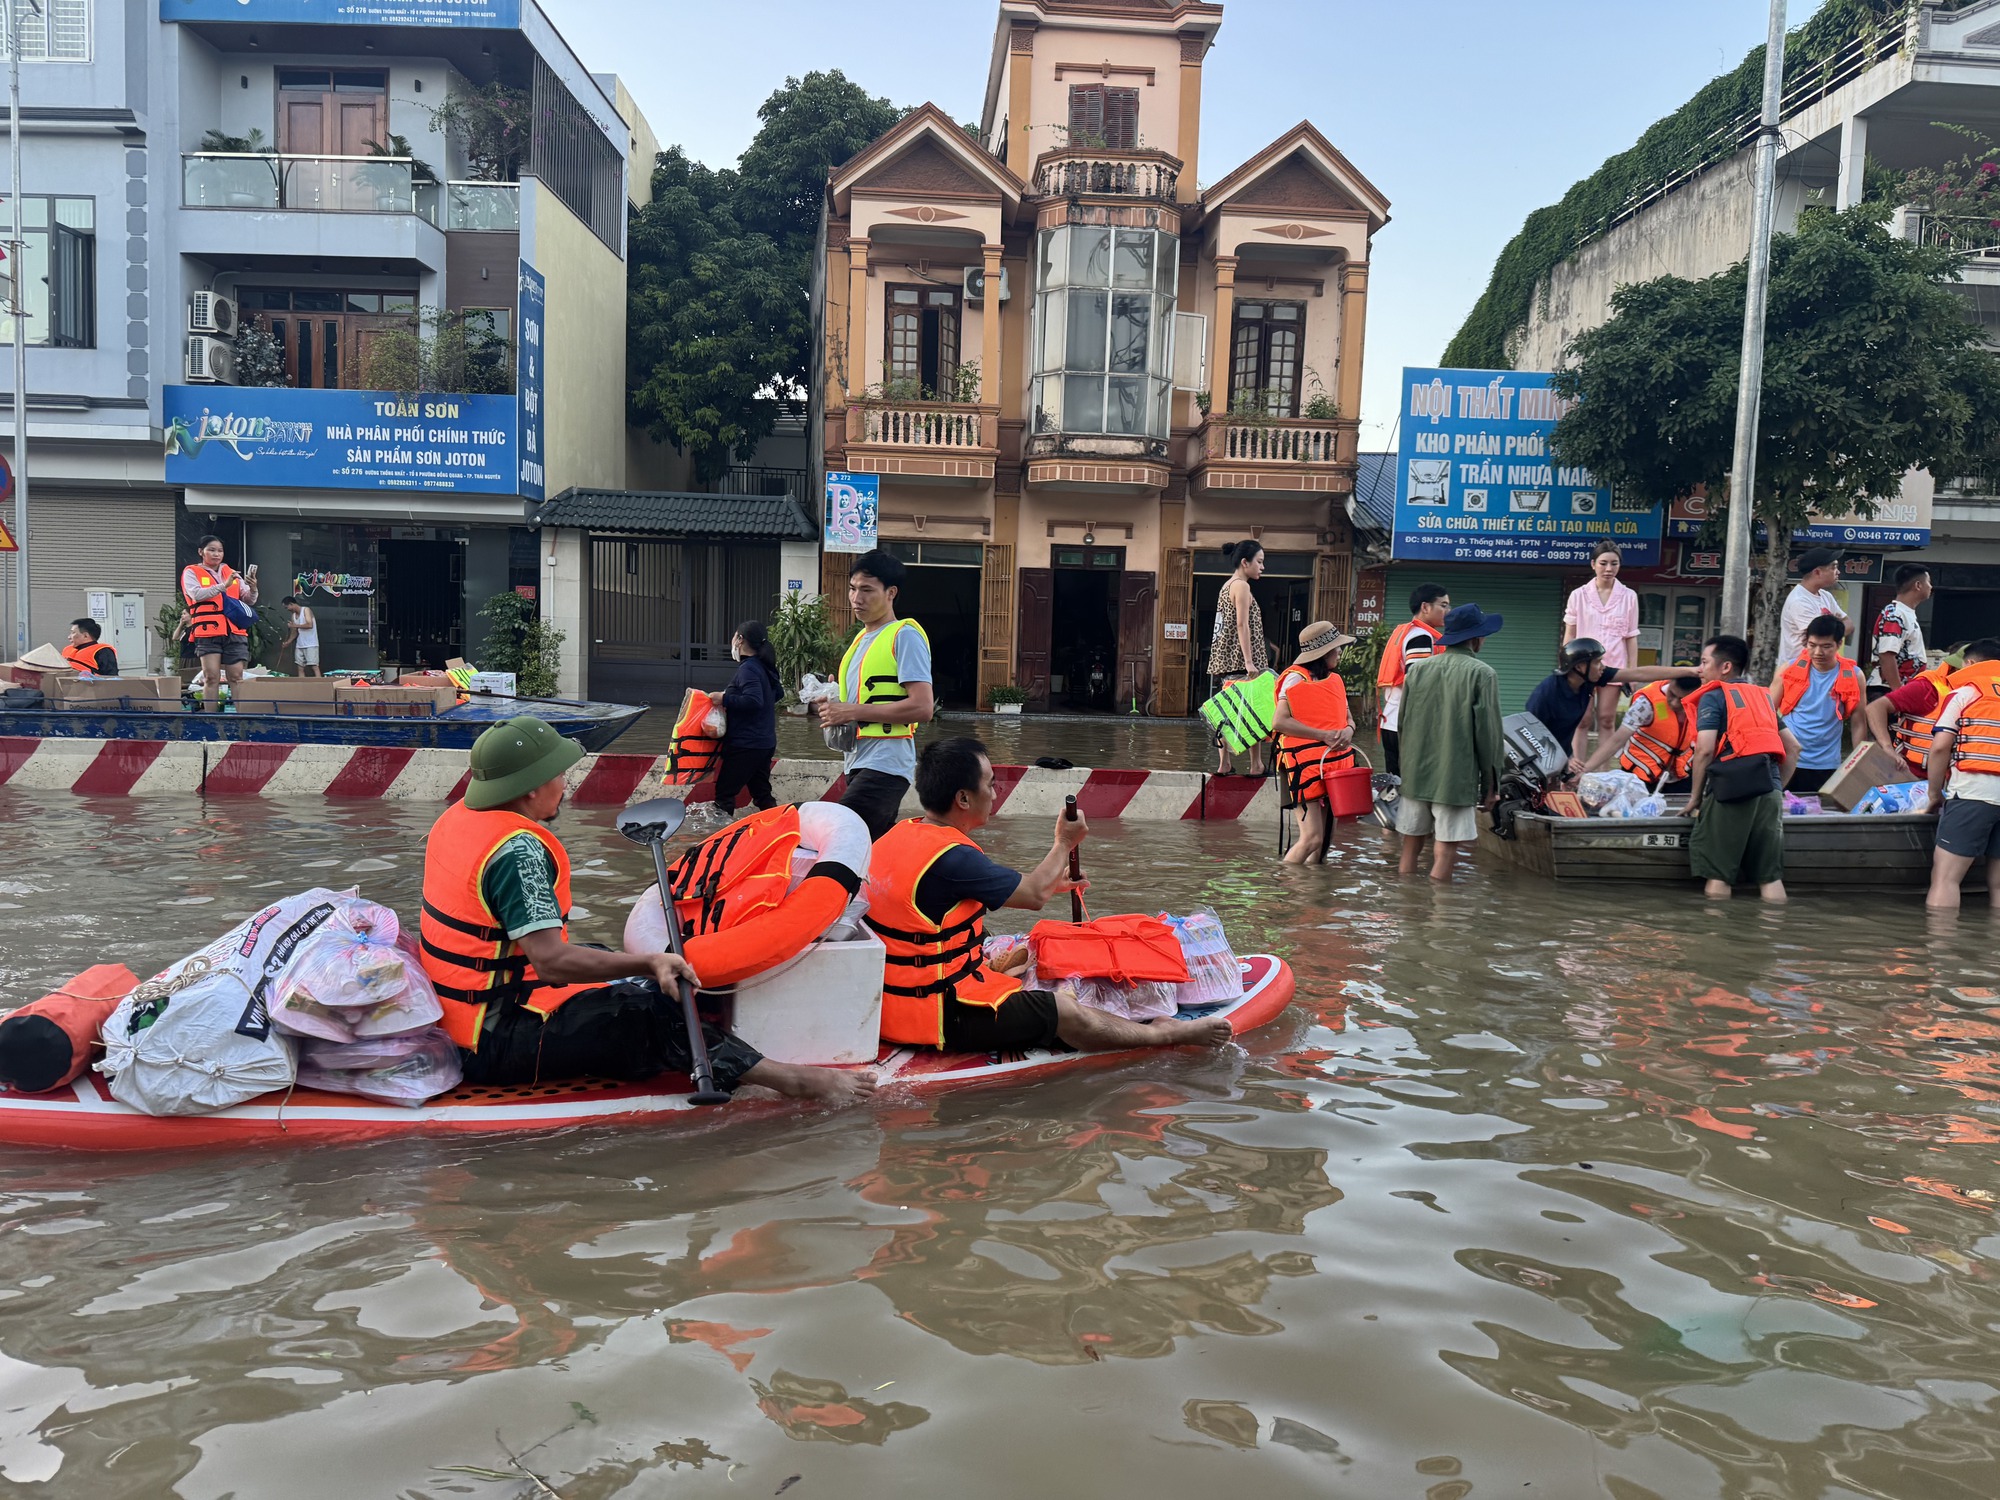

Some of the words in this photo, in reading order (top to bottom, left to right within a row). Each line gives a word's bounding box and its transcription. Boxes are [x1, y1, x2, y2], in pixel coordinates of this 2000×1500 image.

[525, 317, 539, 347] SƠN
[528, 355, 535, 378] &
[424, 402, 459, 419] SƠN
[525, 387, 539, 418] BỘT
[1410, 378, 1452, 424] NỘI
[1457, 375, 1515, 420] THẤT
[326, 424, 353, 440] NHÀ
[356, 425, 390, 442] PHÂN
[394, 424, 425, 443] PHỐI
[428, 426, 468, 444] CHÍNH
[472, 428, 506, 445] THỨC
[526, 424, 537, 454] BẢ
[1415, 432, 1450, 454] KHO
[1454, 430, 1501, 455] PHÂN
[1504, 429, 1545, 457] PHỐI
[347, 446, 371, 463] SẢN
[375, 445, 412, 464] PHẨM
[416, 449, 441, 465] SƠN
[444, 452, 486, 467] JOTON
[341, 466, 350, 475] SỐ
[520, 458, 543, 487] JOTON
[1459, 457, 1504, 485] TRẦN
[1507, 463, 1554, 490] NHỰA
[828, 484, 861, 545] PS
[1417, 511, 1443, 529] SỬA
[1445, 514, 1479, 530] CHỮA
[1482, 515, 1515, 531] THIẾT
[1517, 515, 1534, 532] KẾ
[1536, 514, 1558, 532] CẢI
[1559, 520, 1584, 535] TẠO
[1586, 518, 1611, 534] NHÀ
[1613, 516, 1639, 534] CỬA
[1421, 536, 1433, 544] SN
[1470, 537, 1494, 547] Thống
[1495, 538, 1514, 546] Nhất
[1519, 539, 1541, 547] TPTN
[1806, 528, 1833, 538] Nguyên
[1857, 531, 1881, 540] 0346
[1883, 532, 1901, 541] 757
[1903, 533, 1920, 541] 005
[1455, 548, 1472, 557] ĐT:
[1474, 549, 1493, 558] 096
[1494, 550, 1518, 558] 4141
[1520, 550, 1539, 559] 666
[1547, 551, 1571, 559] 0989
[1573, 551, 1590, 560] 791
[1519, 727, 1549, 759] TOHATSU
